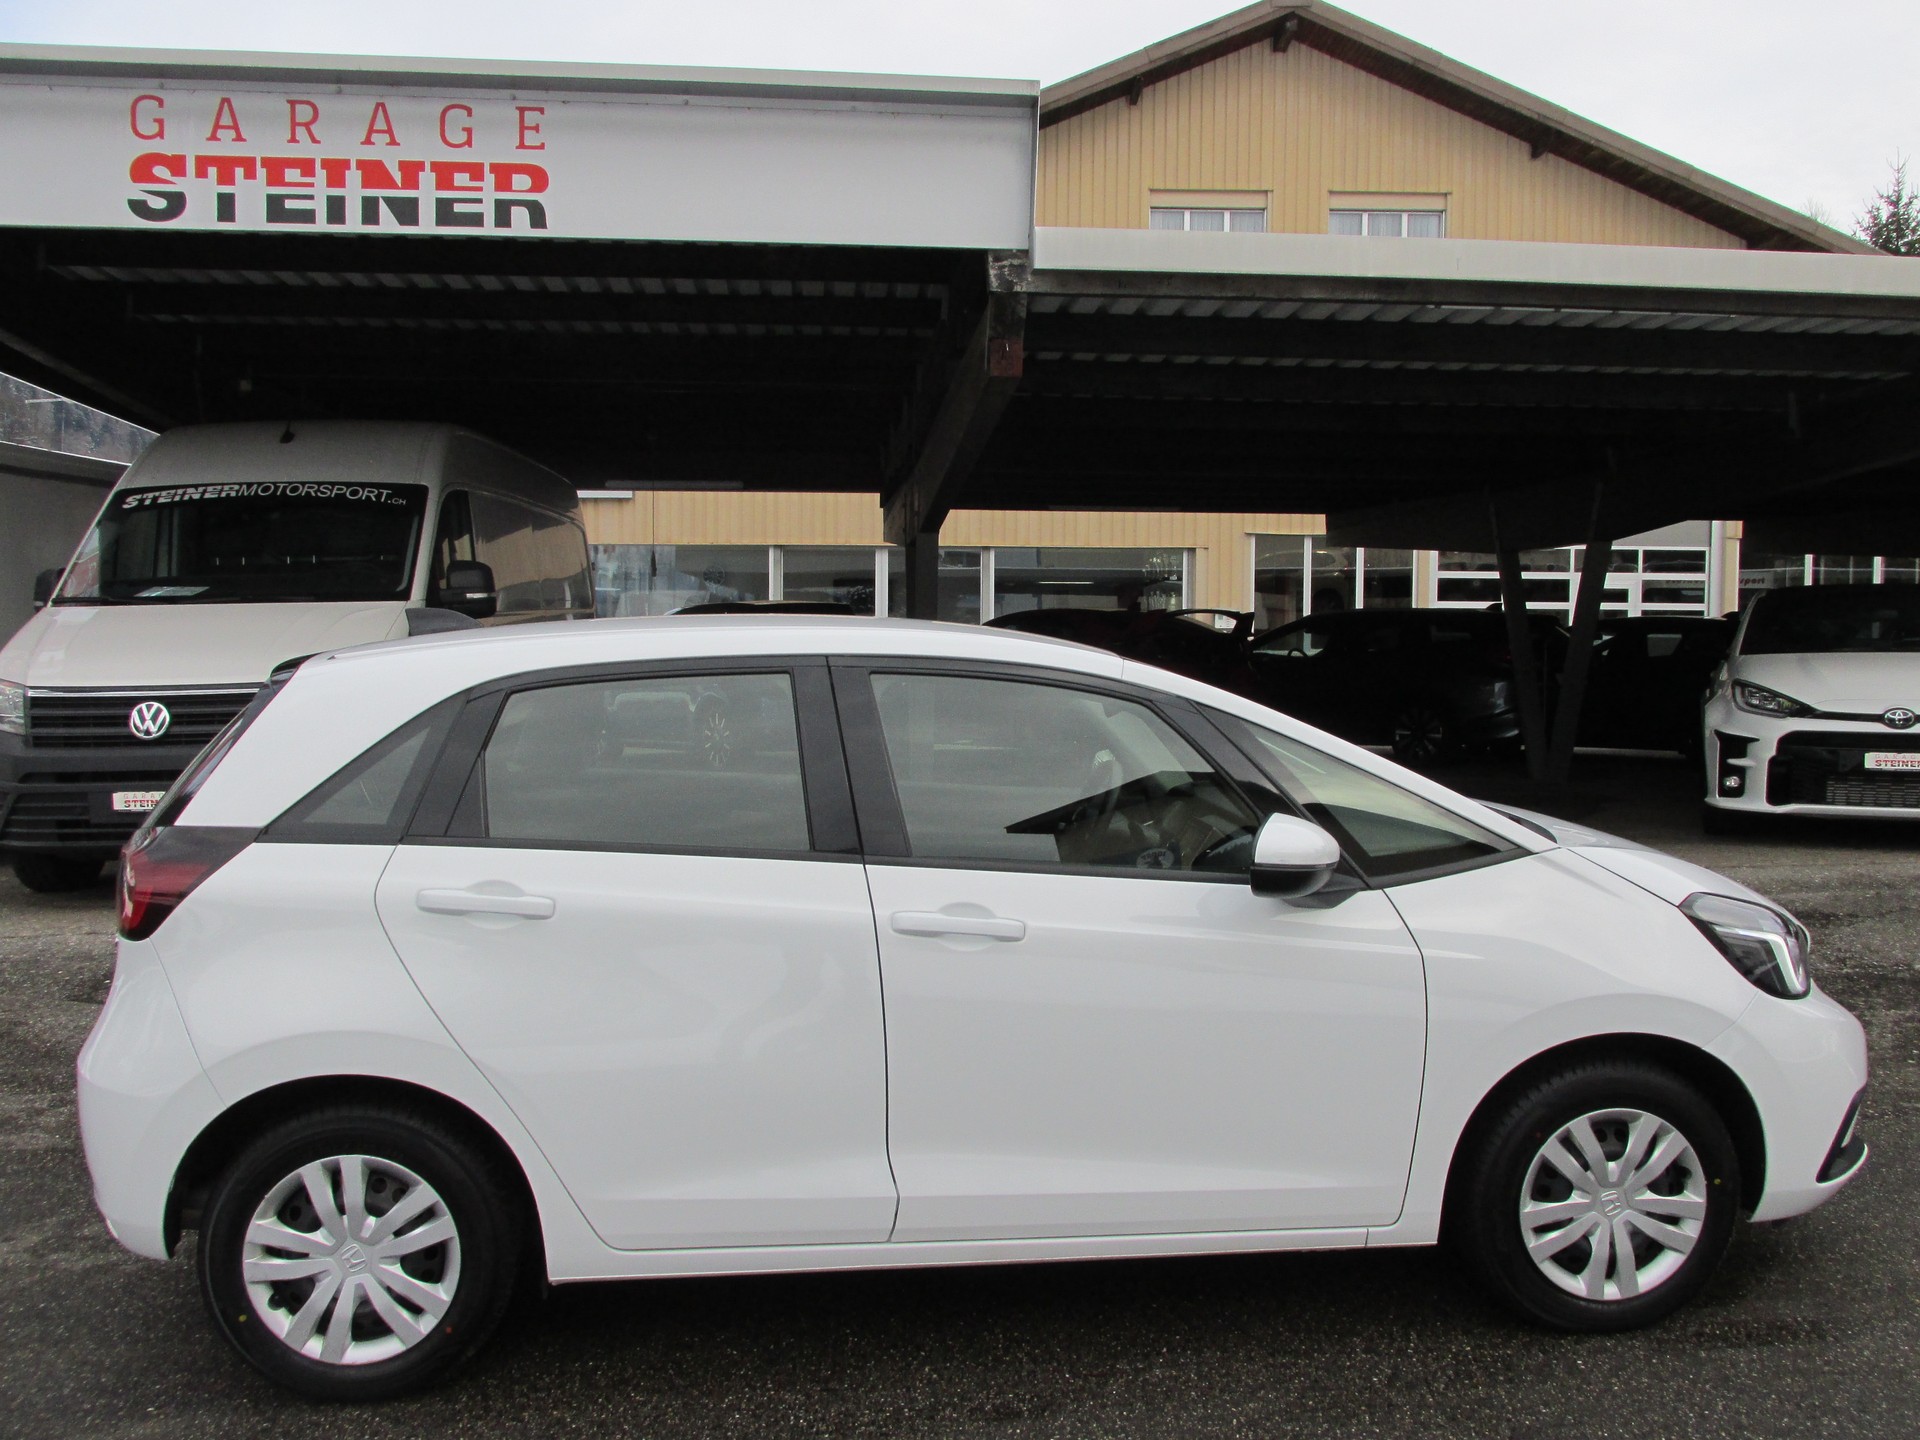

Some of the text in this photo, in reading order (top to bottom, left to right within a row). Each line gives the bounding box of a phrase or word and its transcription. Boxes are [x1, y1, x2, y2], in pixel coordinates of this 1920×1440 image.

[129, 94, 546, 151] GARAGE
[127, 152, 550, 230] STEINER
[124, 800, 160, 808] STEIN
